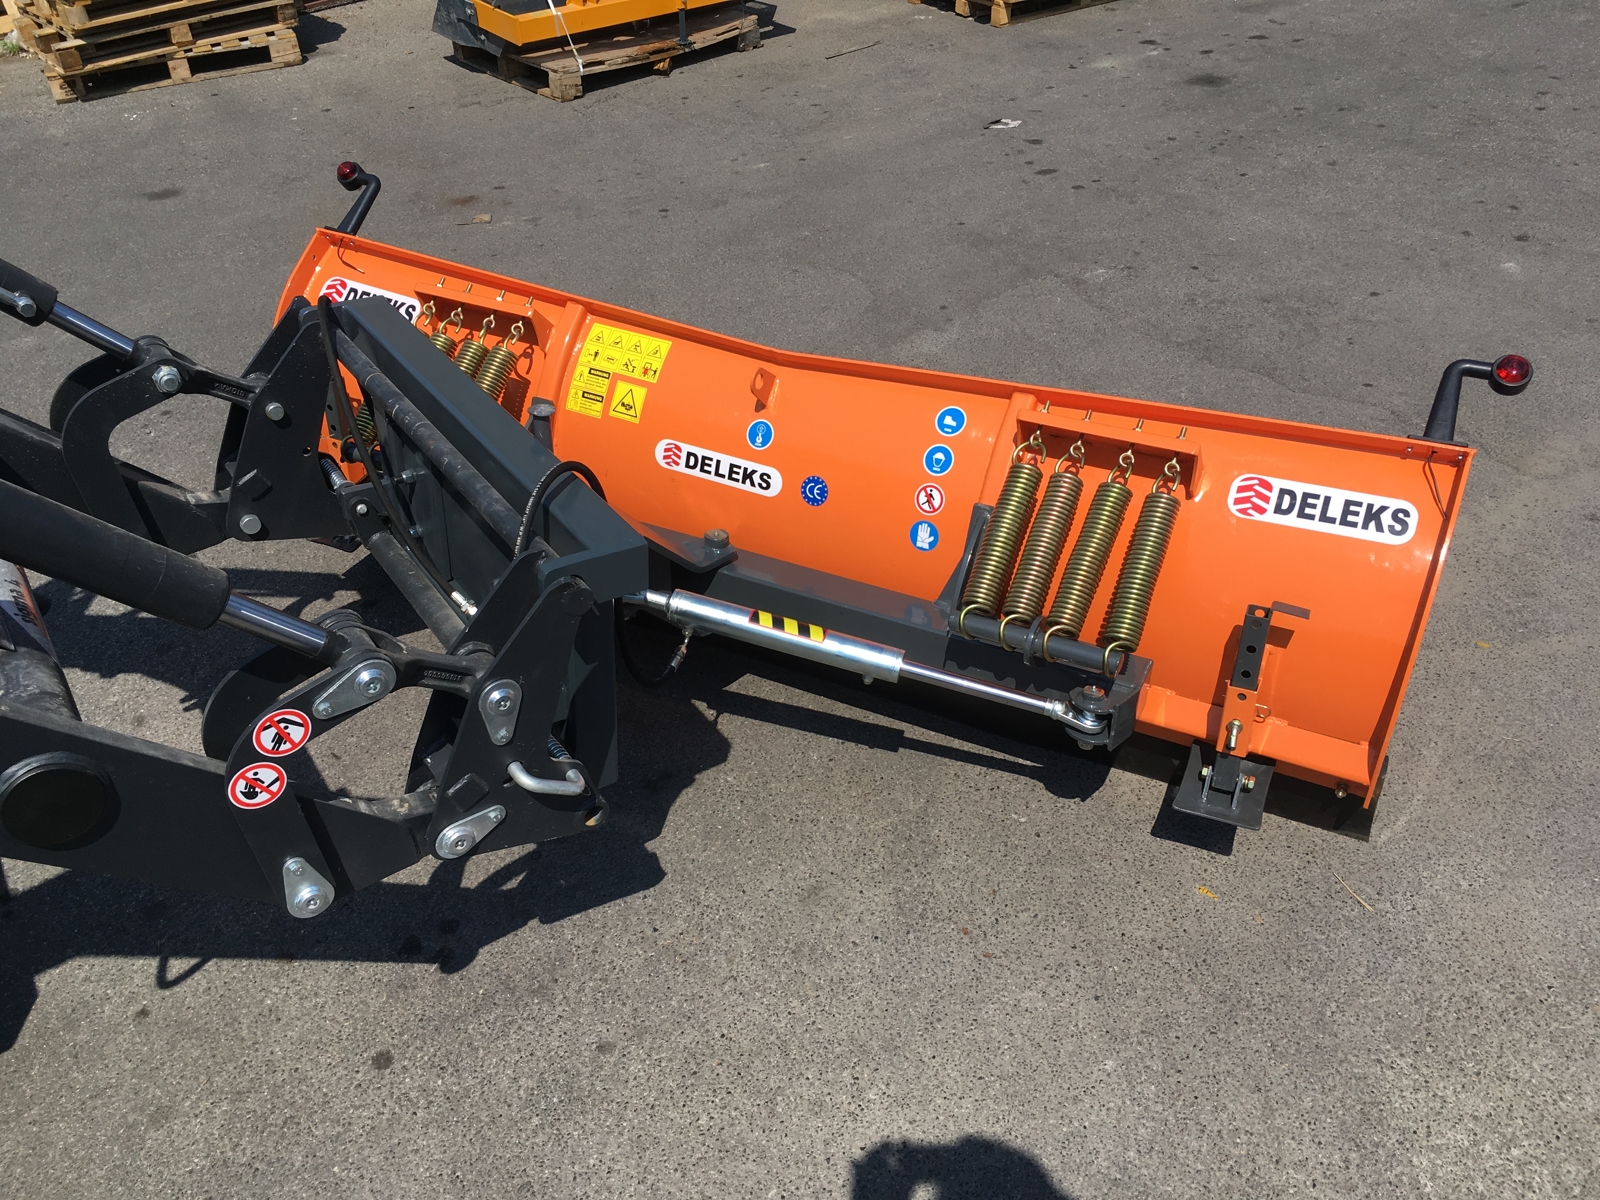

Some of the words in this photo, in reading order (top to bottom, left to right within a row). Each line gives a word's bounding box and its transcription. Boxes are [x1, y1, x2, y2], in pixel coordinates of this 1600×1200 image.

[344, 287, 417, 322] DKS
[684, 451, 772, 491] DELEKS
[805, 483, 823, 500] CE
[1273, 487, 1411, 537] DELEKS
